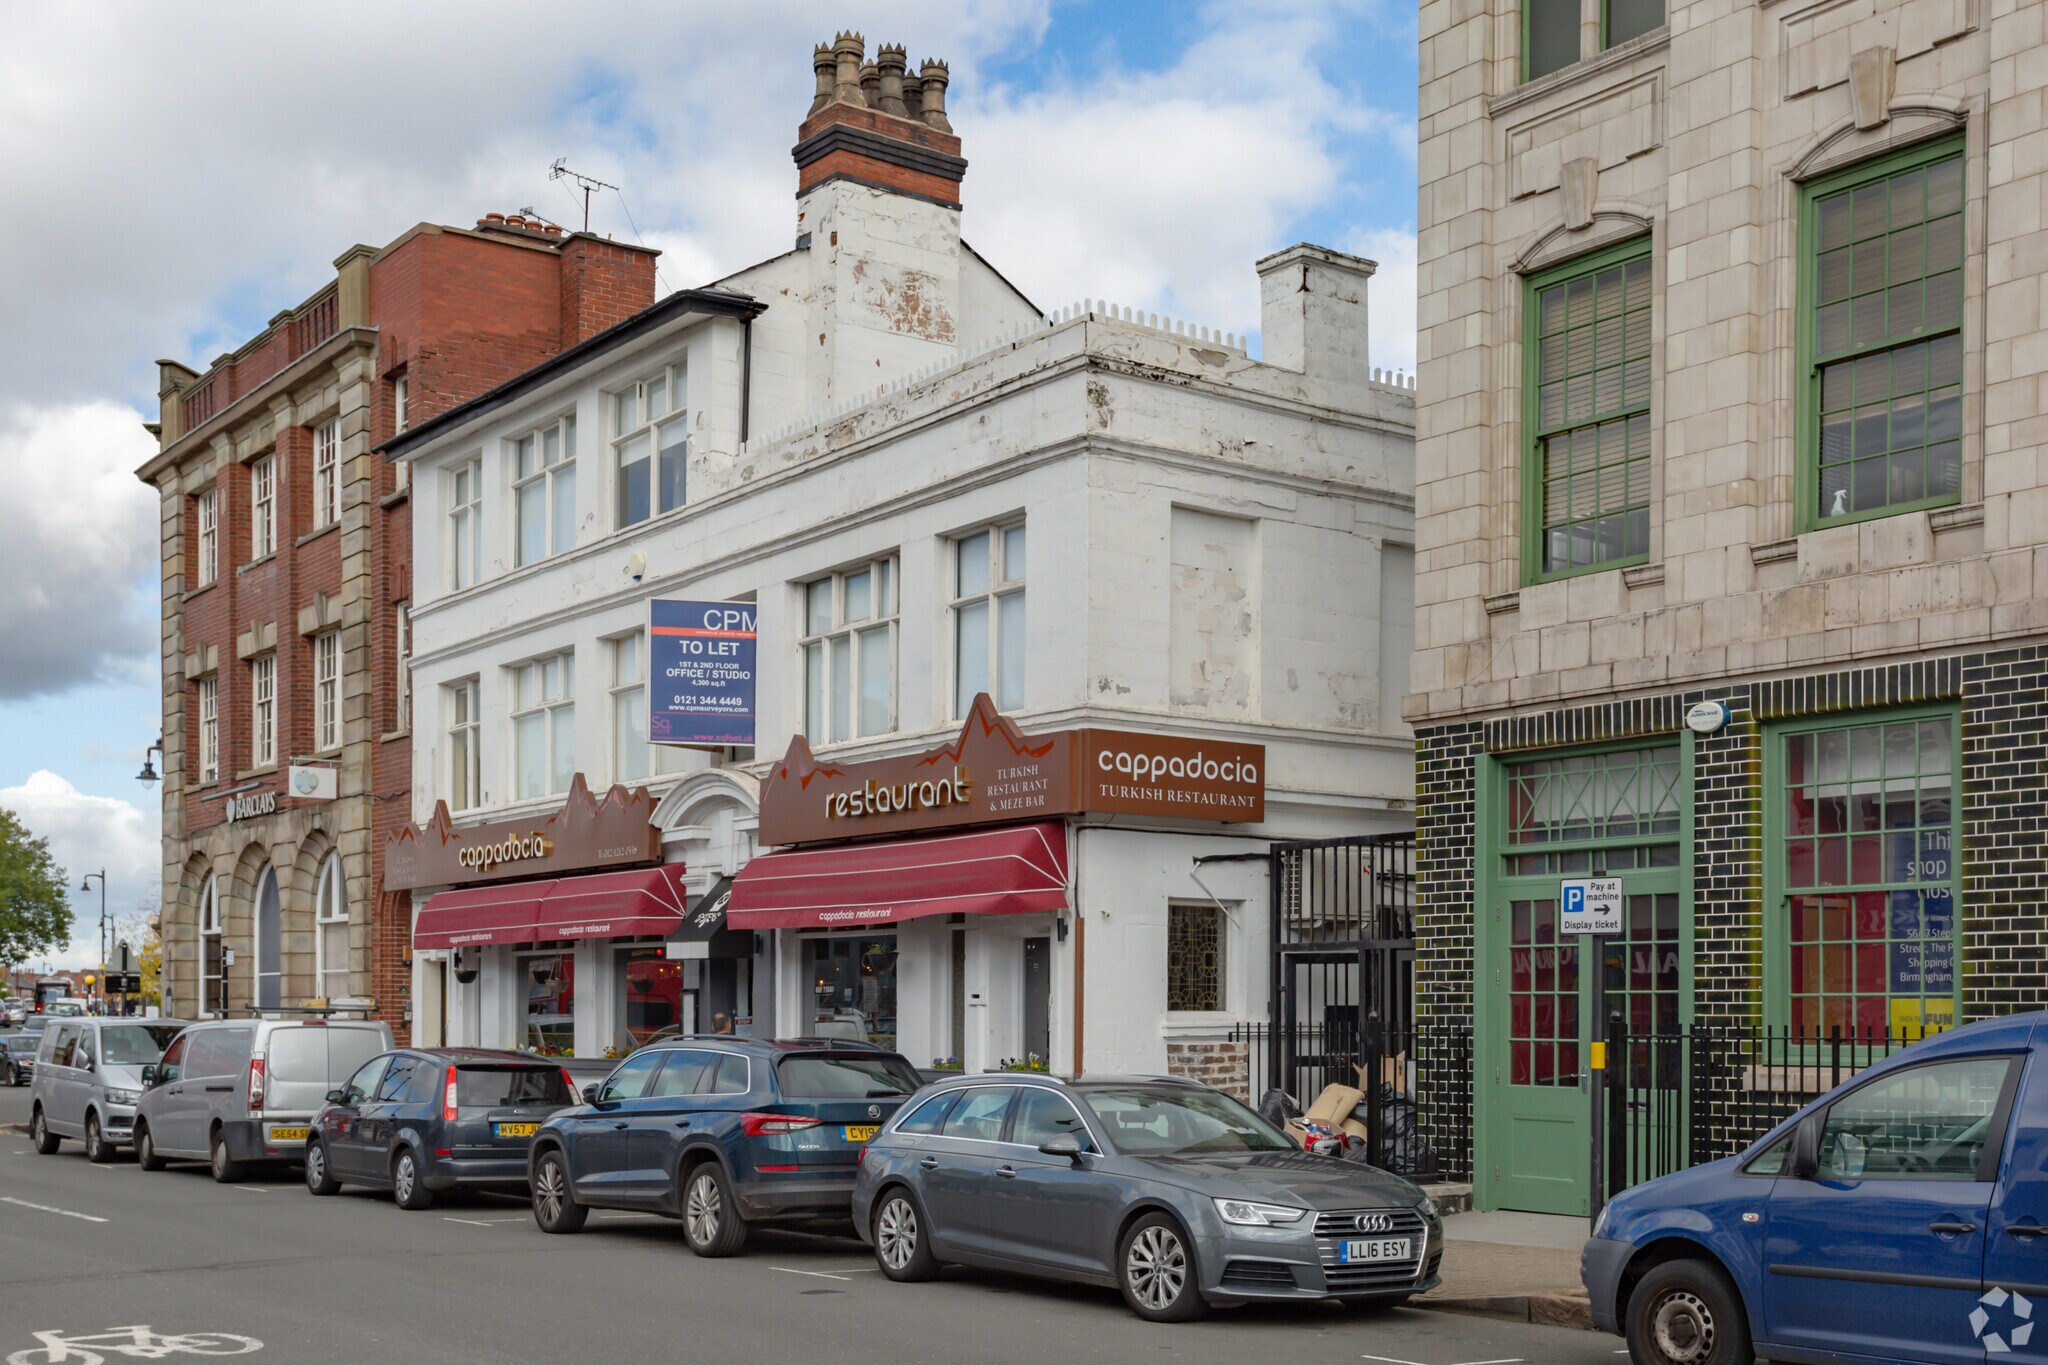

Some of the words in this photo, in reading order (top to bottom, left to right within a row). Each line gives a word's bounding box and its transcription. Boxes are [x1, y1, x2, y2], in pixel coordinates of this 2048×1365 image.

[703, 609, 757, 632] CPM
[679, 640, 703, 655] TO
[708, 642, 740, 656] LET
[666, 668, 704, 678] OFFICE
[705, 670, 710, 678] /
[712, 670, 751, 680] STUDIO
[674, 695, 697, 704] 0121
[700, 696, 717, 705] 344
[719, 697, 742, 706] 4449
[668, 704, 749, 713] www.cpmsurveyors.com
[693, 734, 754, 743] www.sqfoot.uk
[996, 764, 1038, 780] TURKISH
[1098, 750, 1257, 784] cappadocia
[825, 766, 964, 818] restaurant
[987, 779, 1049, 796] RESTAURANT
[1099, 784, 1163, 801] TURKISH
[1167, 790, 1256, 808] RESTAURANT
[235, 792, 276, 819] BARCLAYS
[989, 801, 998, 811] &
[1000, 797, 1024, 810] MEZE
[1026, 795, 1045, 807] BAR
[459, 831, 544, 873] cappadocia
[1590, 882, 1605, 892] Pay
[1607, 882, 1616, 890] at
[1918, 887, 1953, 899] los
[1568, 889, 1581, 911] P
[1586, 892, 1619, 901] machine
[818, 910, 855, 923] cappadocia
[856, 907, 892, 919] restaurant
[1564, 920, 1593, 930] Display
[1595, 920, 1618, 929] ticket
[1931, 943, 1946, 953] The
[1907, 957, 1948, 969] Shpping
[1900, 971, 1954, 984] Birmngham,
[1924, 1013, 1953, 1026] FUN
[274, 1129, 297, 1138] SE54
[500, 1124, 526, 1134] MV57
[850, 1127, 875, 1139] CY19
[1350, 1242, 1379, 1259] LL16
[1383, 1241, 1407, 1258] ESY
